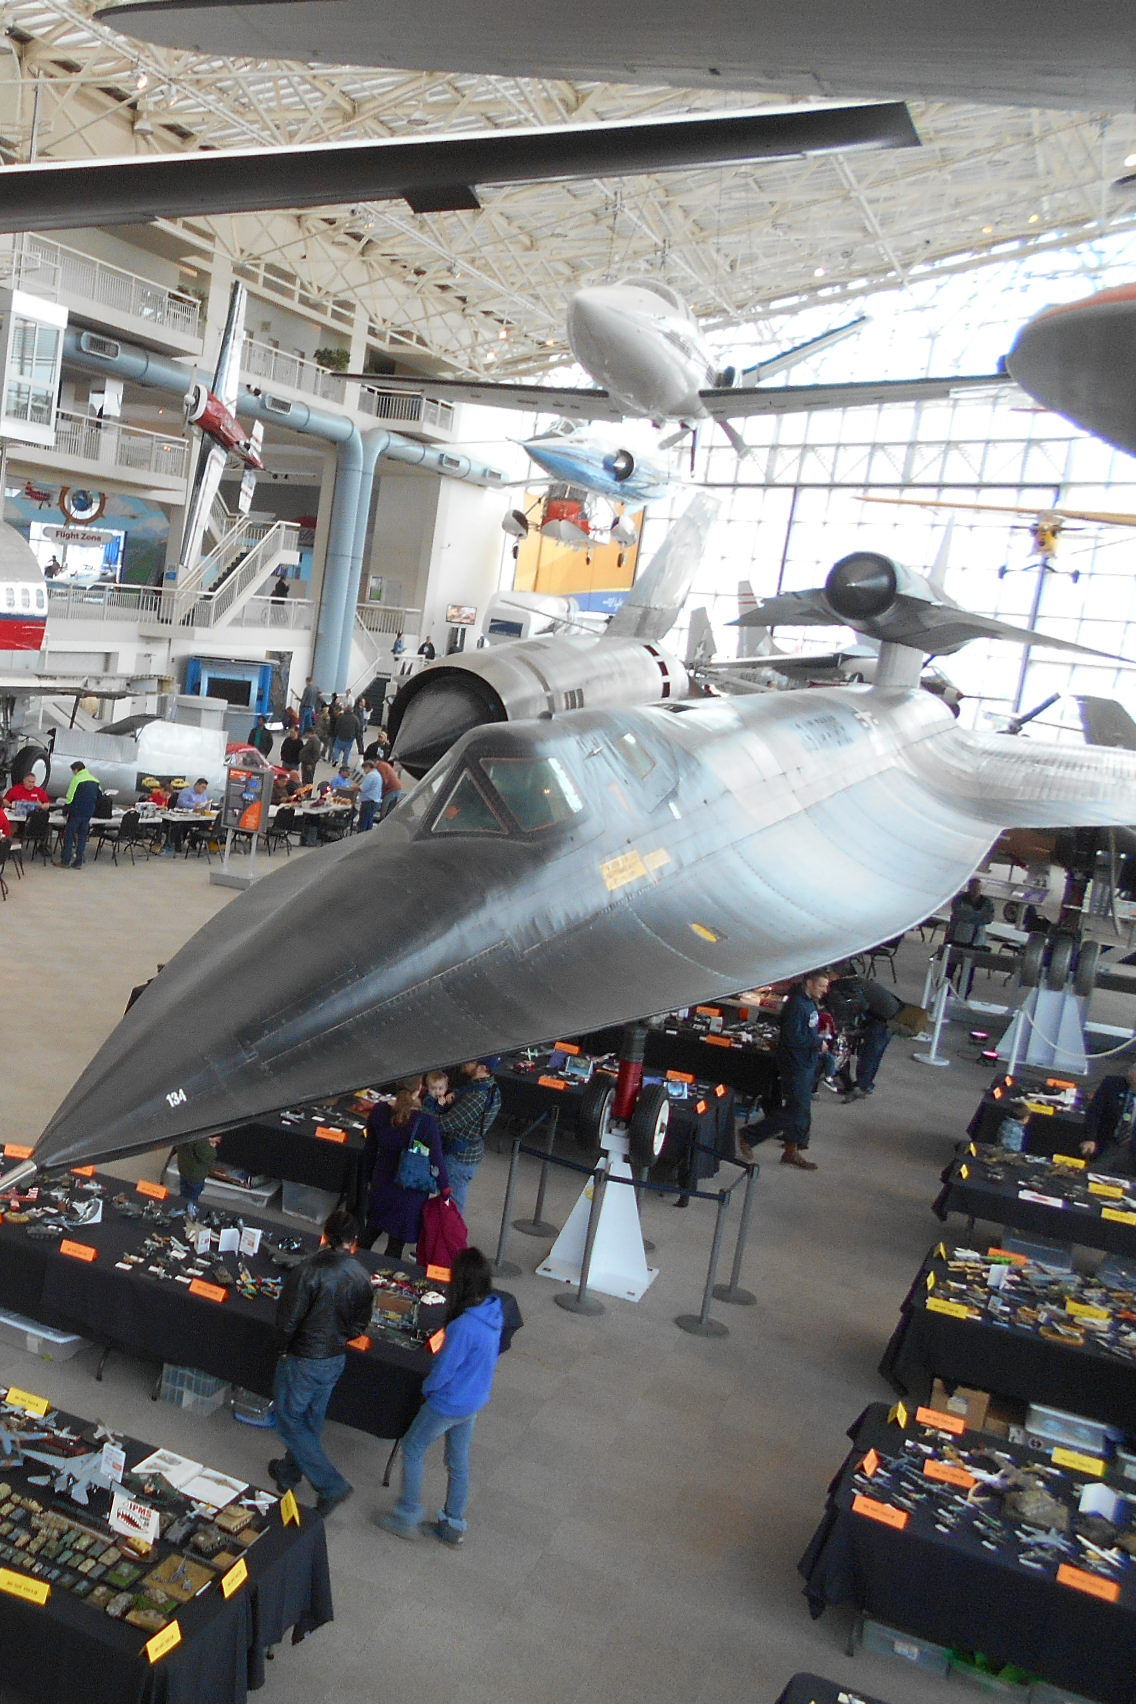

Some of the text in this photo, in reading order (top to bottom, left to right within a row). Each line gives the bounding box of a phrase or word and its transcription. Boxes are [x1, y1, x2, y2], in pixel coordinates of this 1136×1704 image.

[55, 530, 102, 542] Flight Zone
[166, 1088, 187, 1108] 134
[128, 1502, 152, 1519] IPMS
